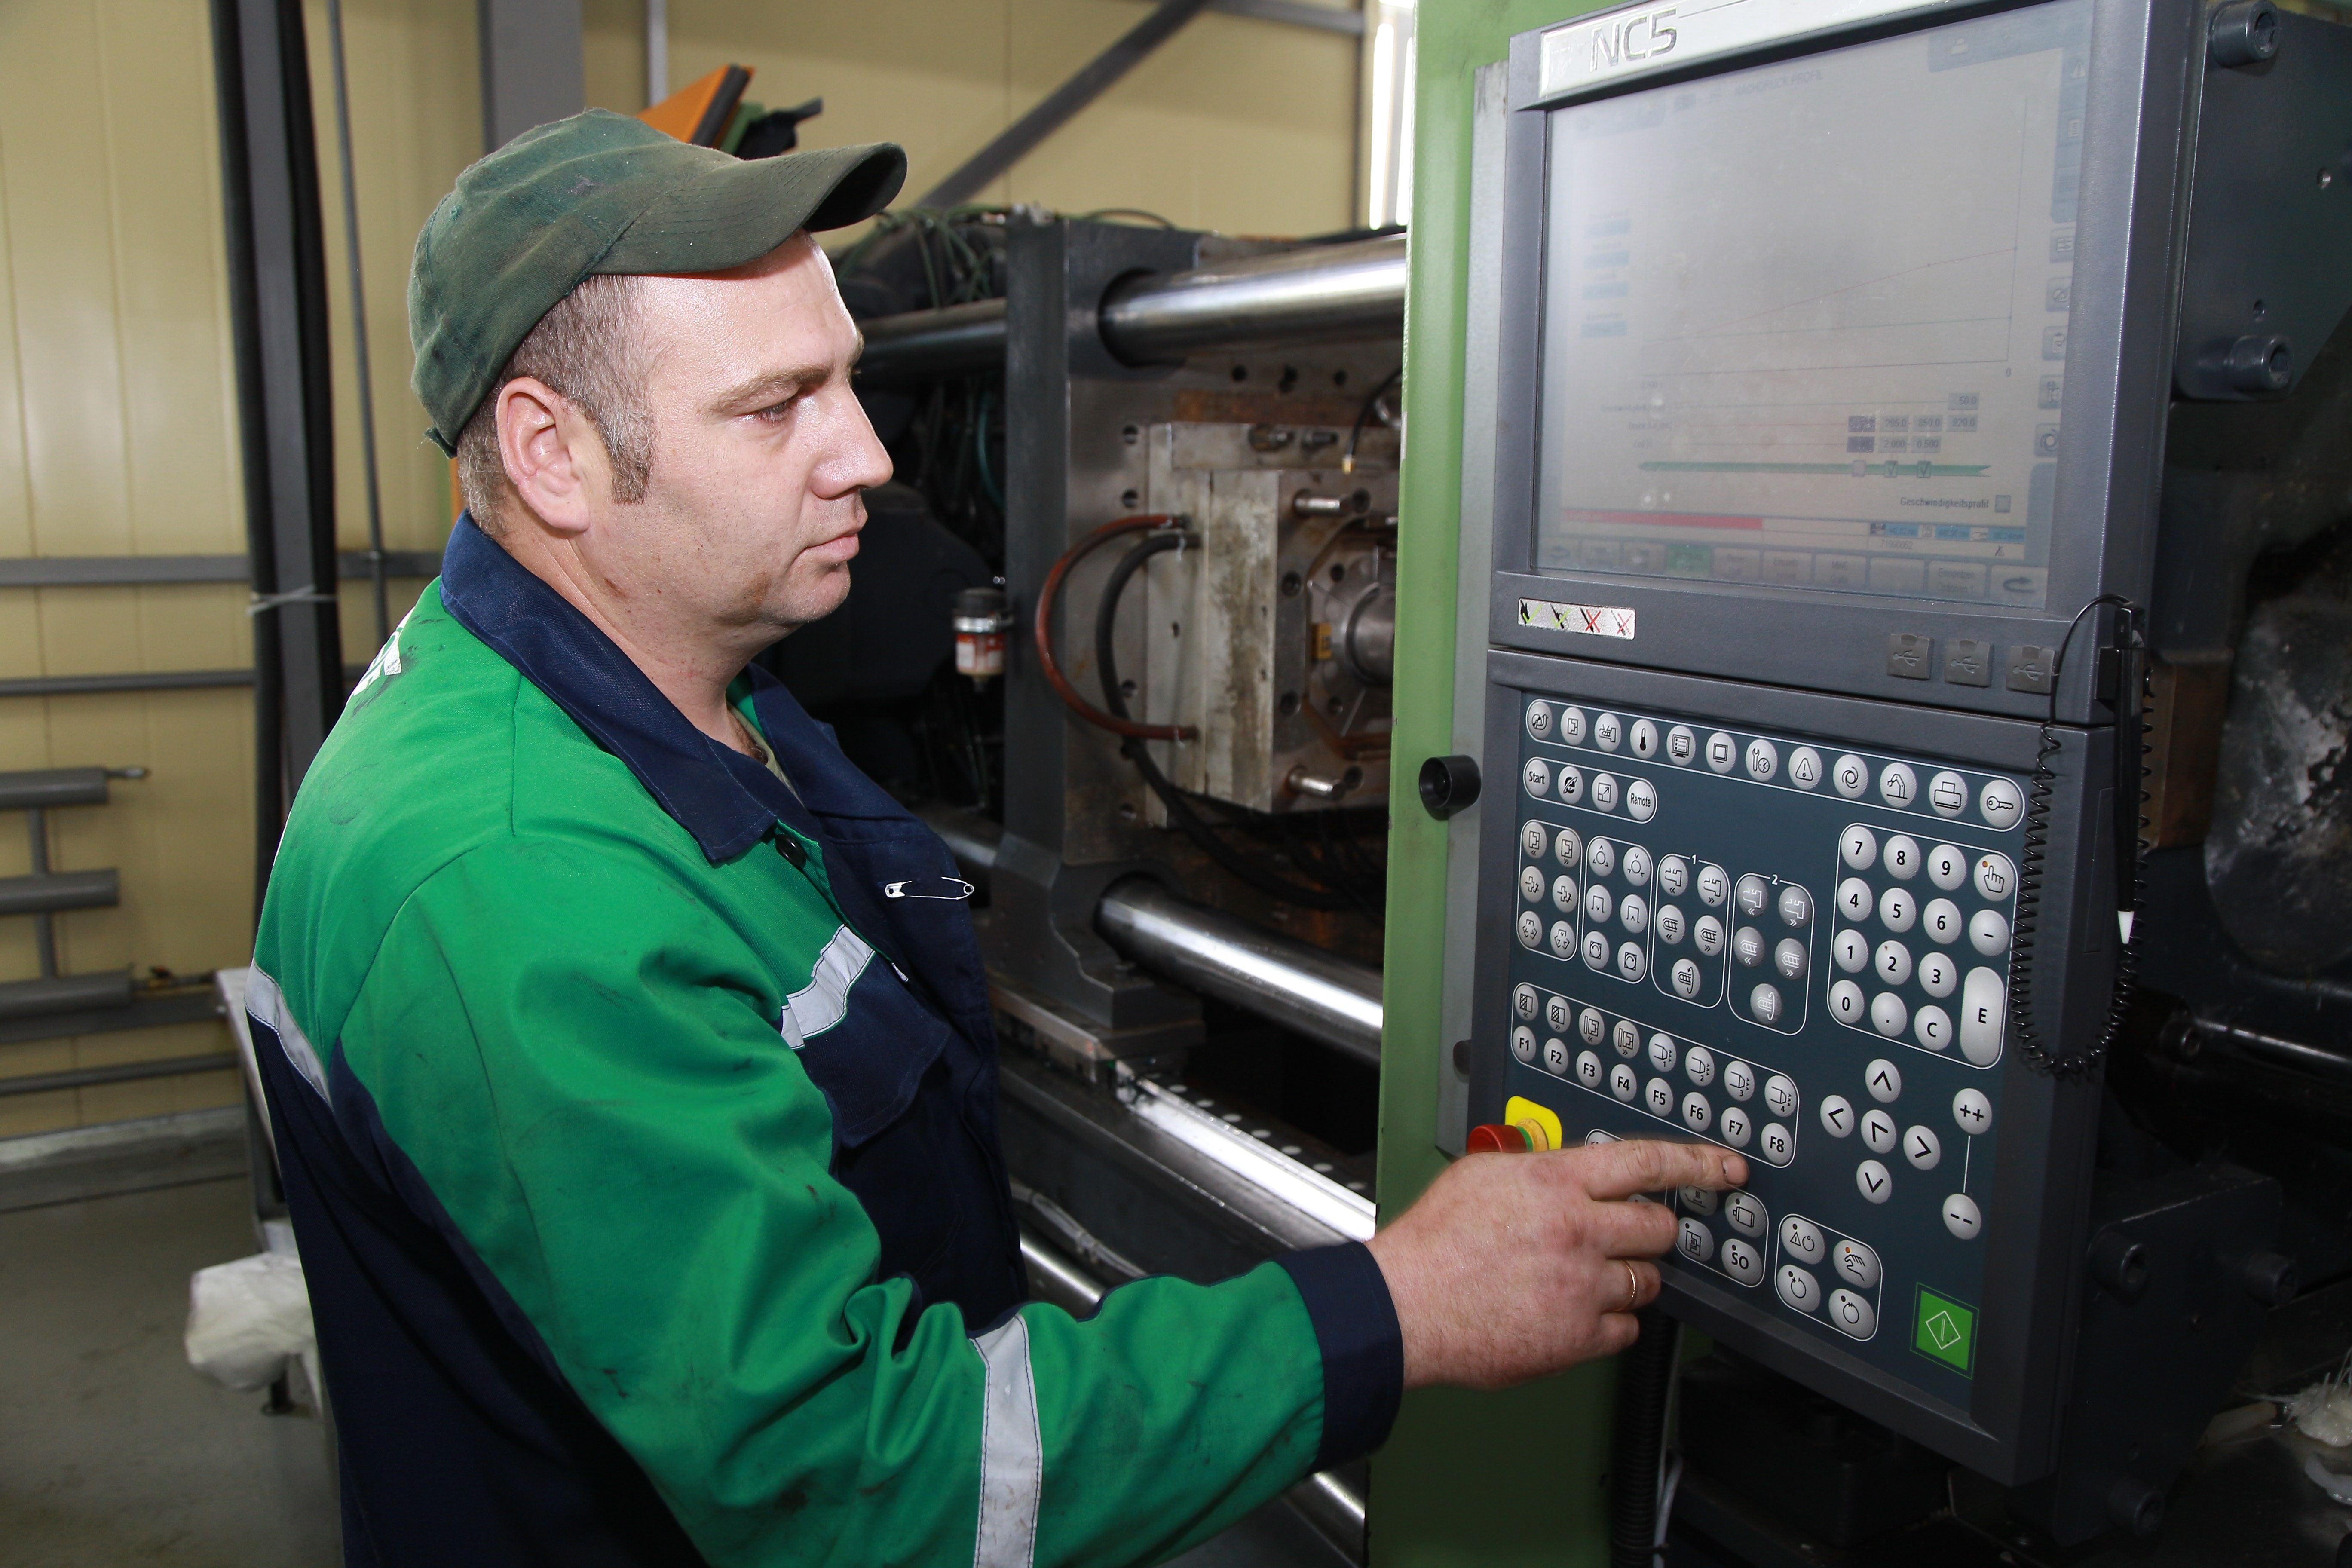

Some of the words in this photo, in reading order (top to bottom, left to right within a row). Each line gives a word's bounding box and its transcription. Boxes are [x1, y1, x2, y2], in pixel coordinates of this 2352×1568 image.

[1589, 6, 1677, 72] NC5
[1900, 497, 1989, 509] Geschwindigkeitsprofil
[1529, 771, 1545, 785] Start
[1630, 793, 1651, 808] Remote
[1692, 854, 1696, 865] 1
[1855, 841, 1863, 855] 7
[1896, 850, 1905, 866] 8
[1942, 861, 1951, 876] 9
[1772, 874, 1778, 885] 2
[1850, 894, 1859, 908] 4
[1893, 903, 1901, 919] 5
[1937, 915, 1946, 930] 6
[1847, 945, 1853, 959] 1
[1888, 956, 1896, 972] 2
[1932, 969, 1941, 984] 3
[1842, 997, 1850, 1011] 0
[1927, 1022, 1937, 1038] C
[1978, 1008, 1988, 1024] E
[1519, 1037, 1529, 1052] F1
[1551, 1050, 1562, 1065] F2
[1583, 1063, 1595, 1078] F3
[1617, 1076, 1630, 1091] F4
[1653, 1090, 1666, 1106] F5
[1690, 1104, 1703, 1121] F6
[1729, 1120, 1743, 1136] F7
[1770, 1136, 1784, 1153] F8
